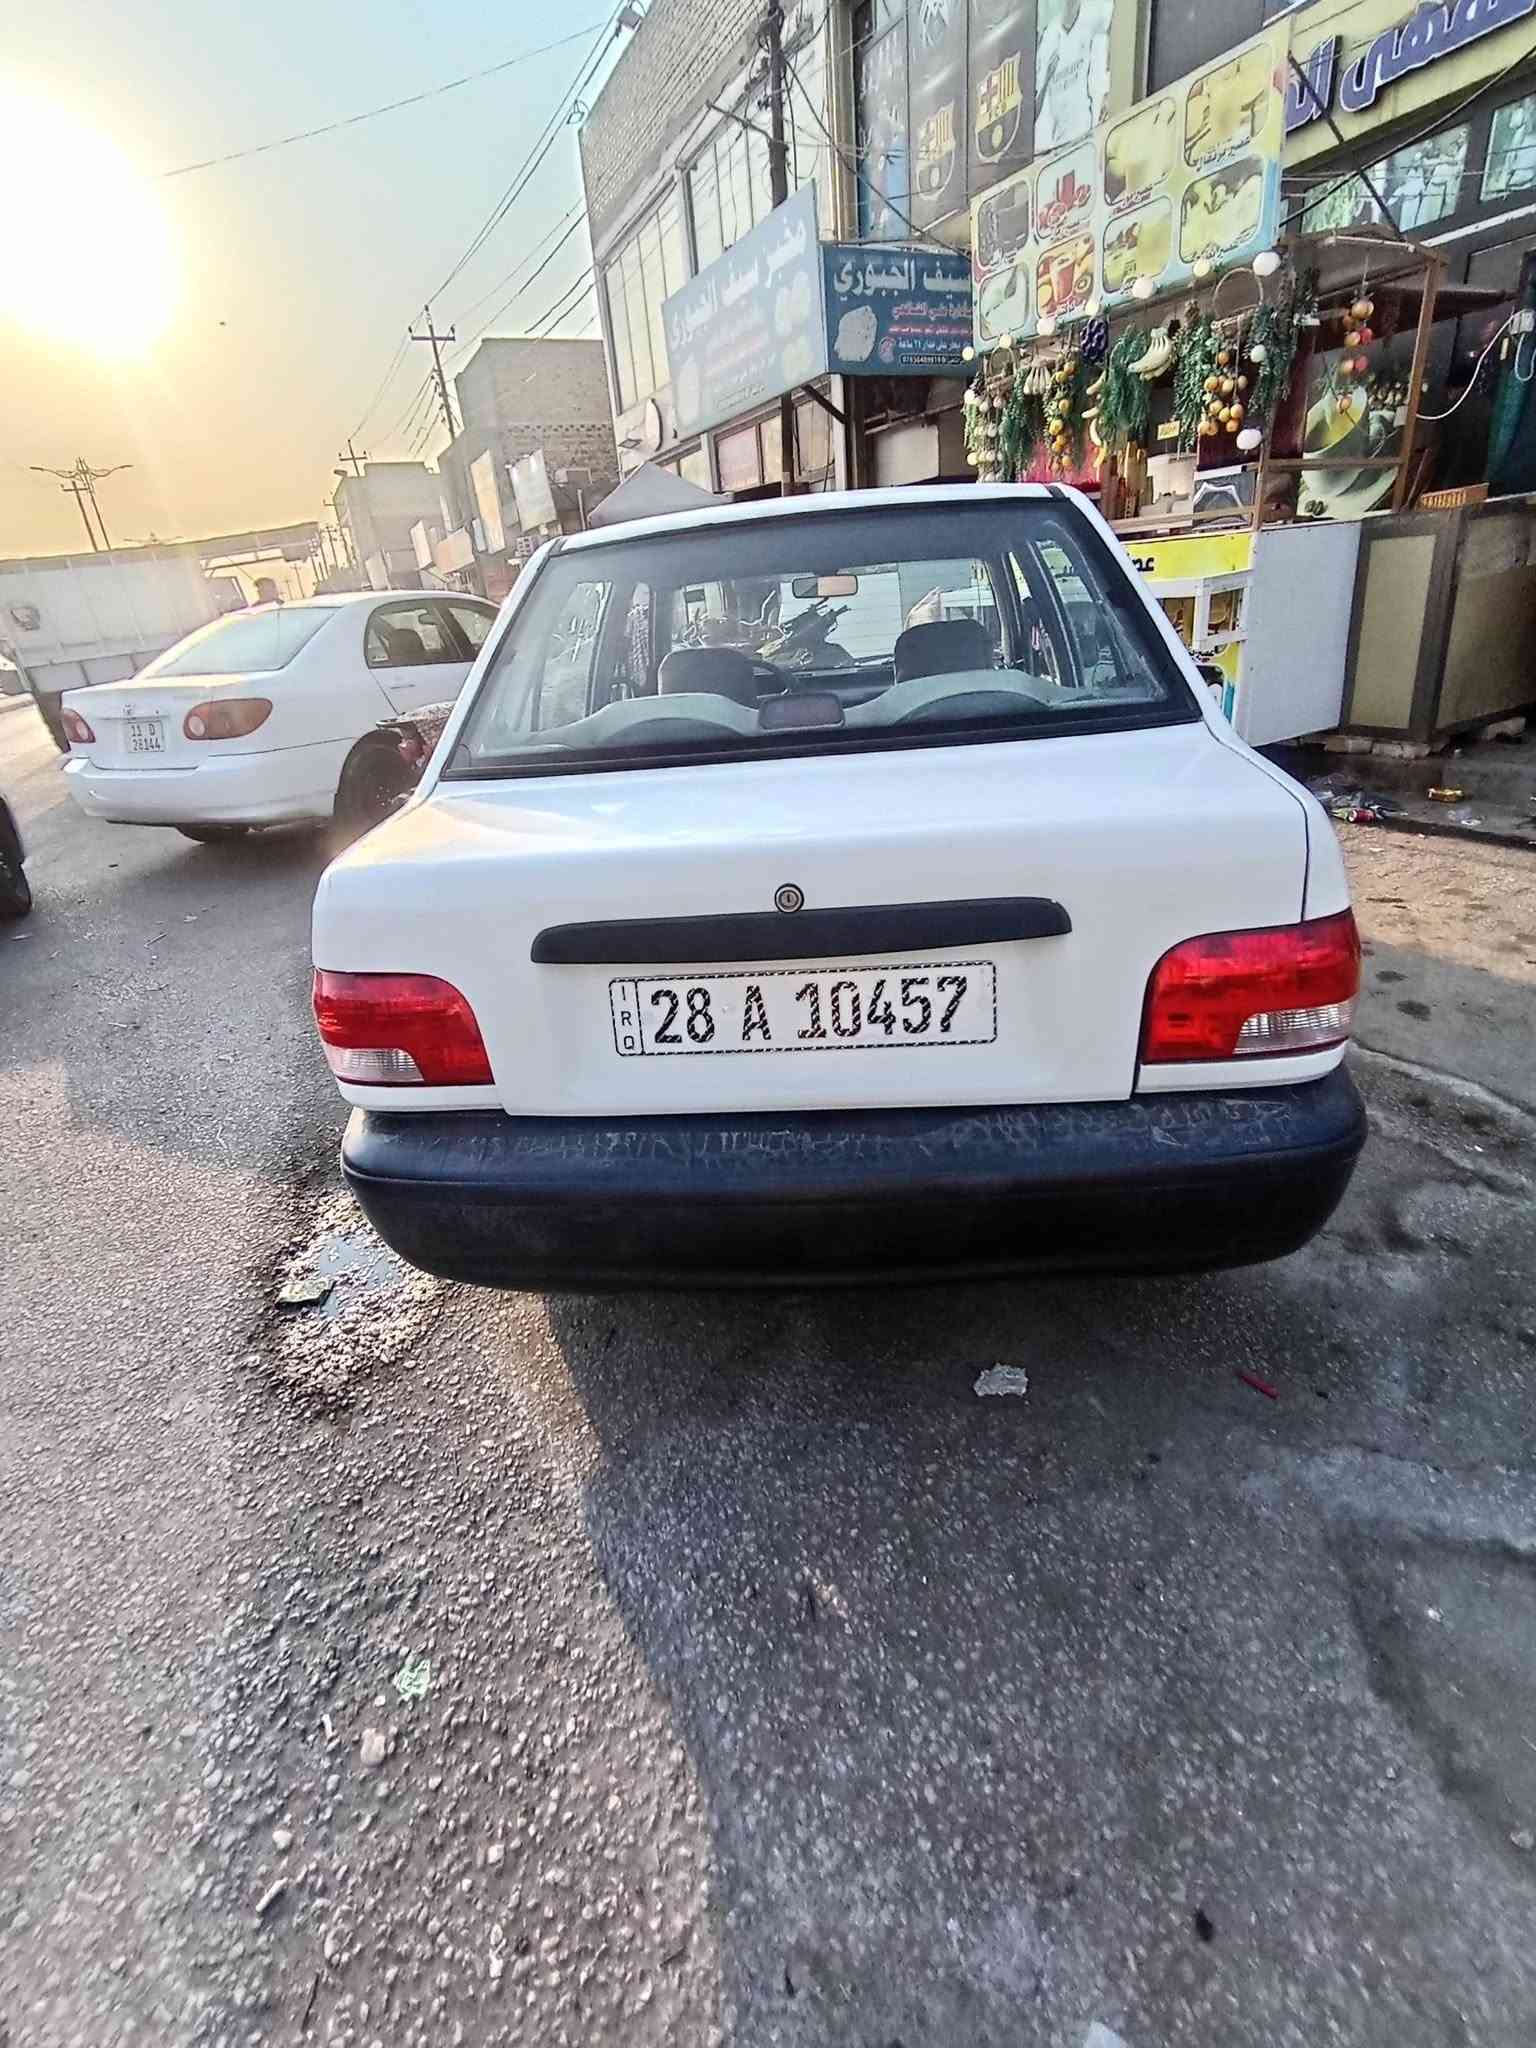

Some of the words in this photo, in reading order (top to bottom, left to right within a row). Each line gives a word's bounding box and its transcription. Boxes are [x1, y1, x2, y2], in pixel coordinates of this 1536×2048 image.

[833, 258, 915, 302] الجبوري
[620, 985, 635, 1050] IRQ
[651, 988, 715, 1043] 28
[743, 985, 772, 1041] A
[796, 975, 968, 1039] 10457
